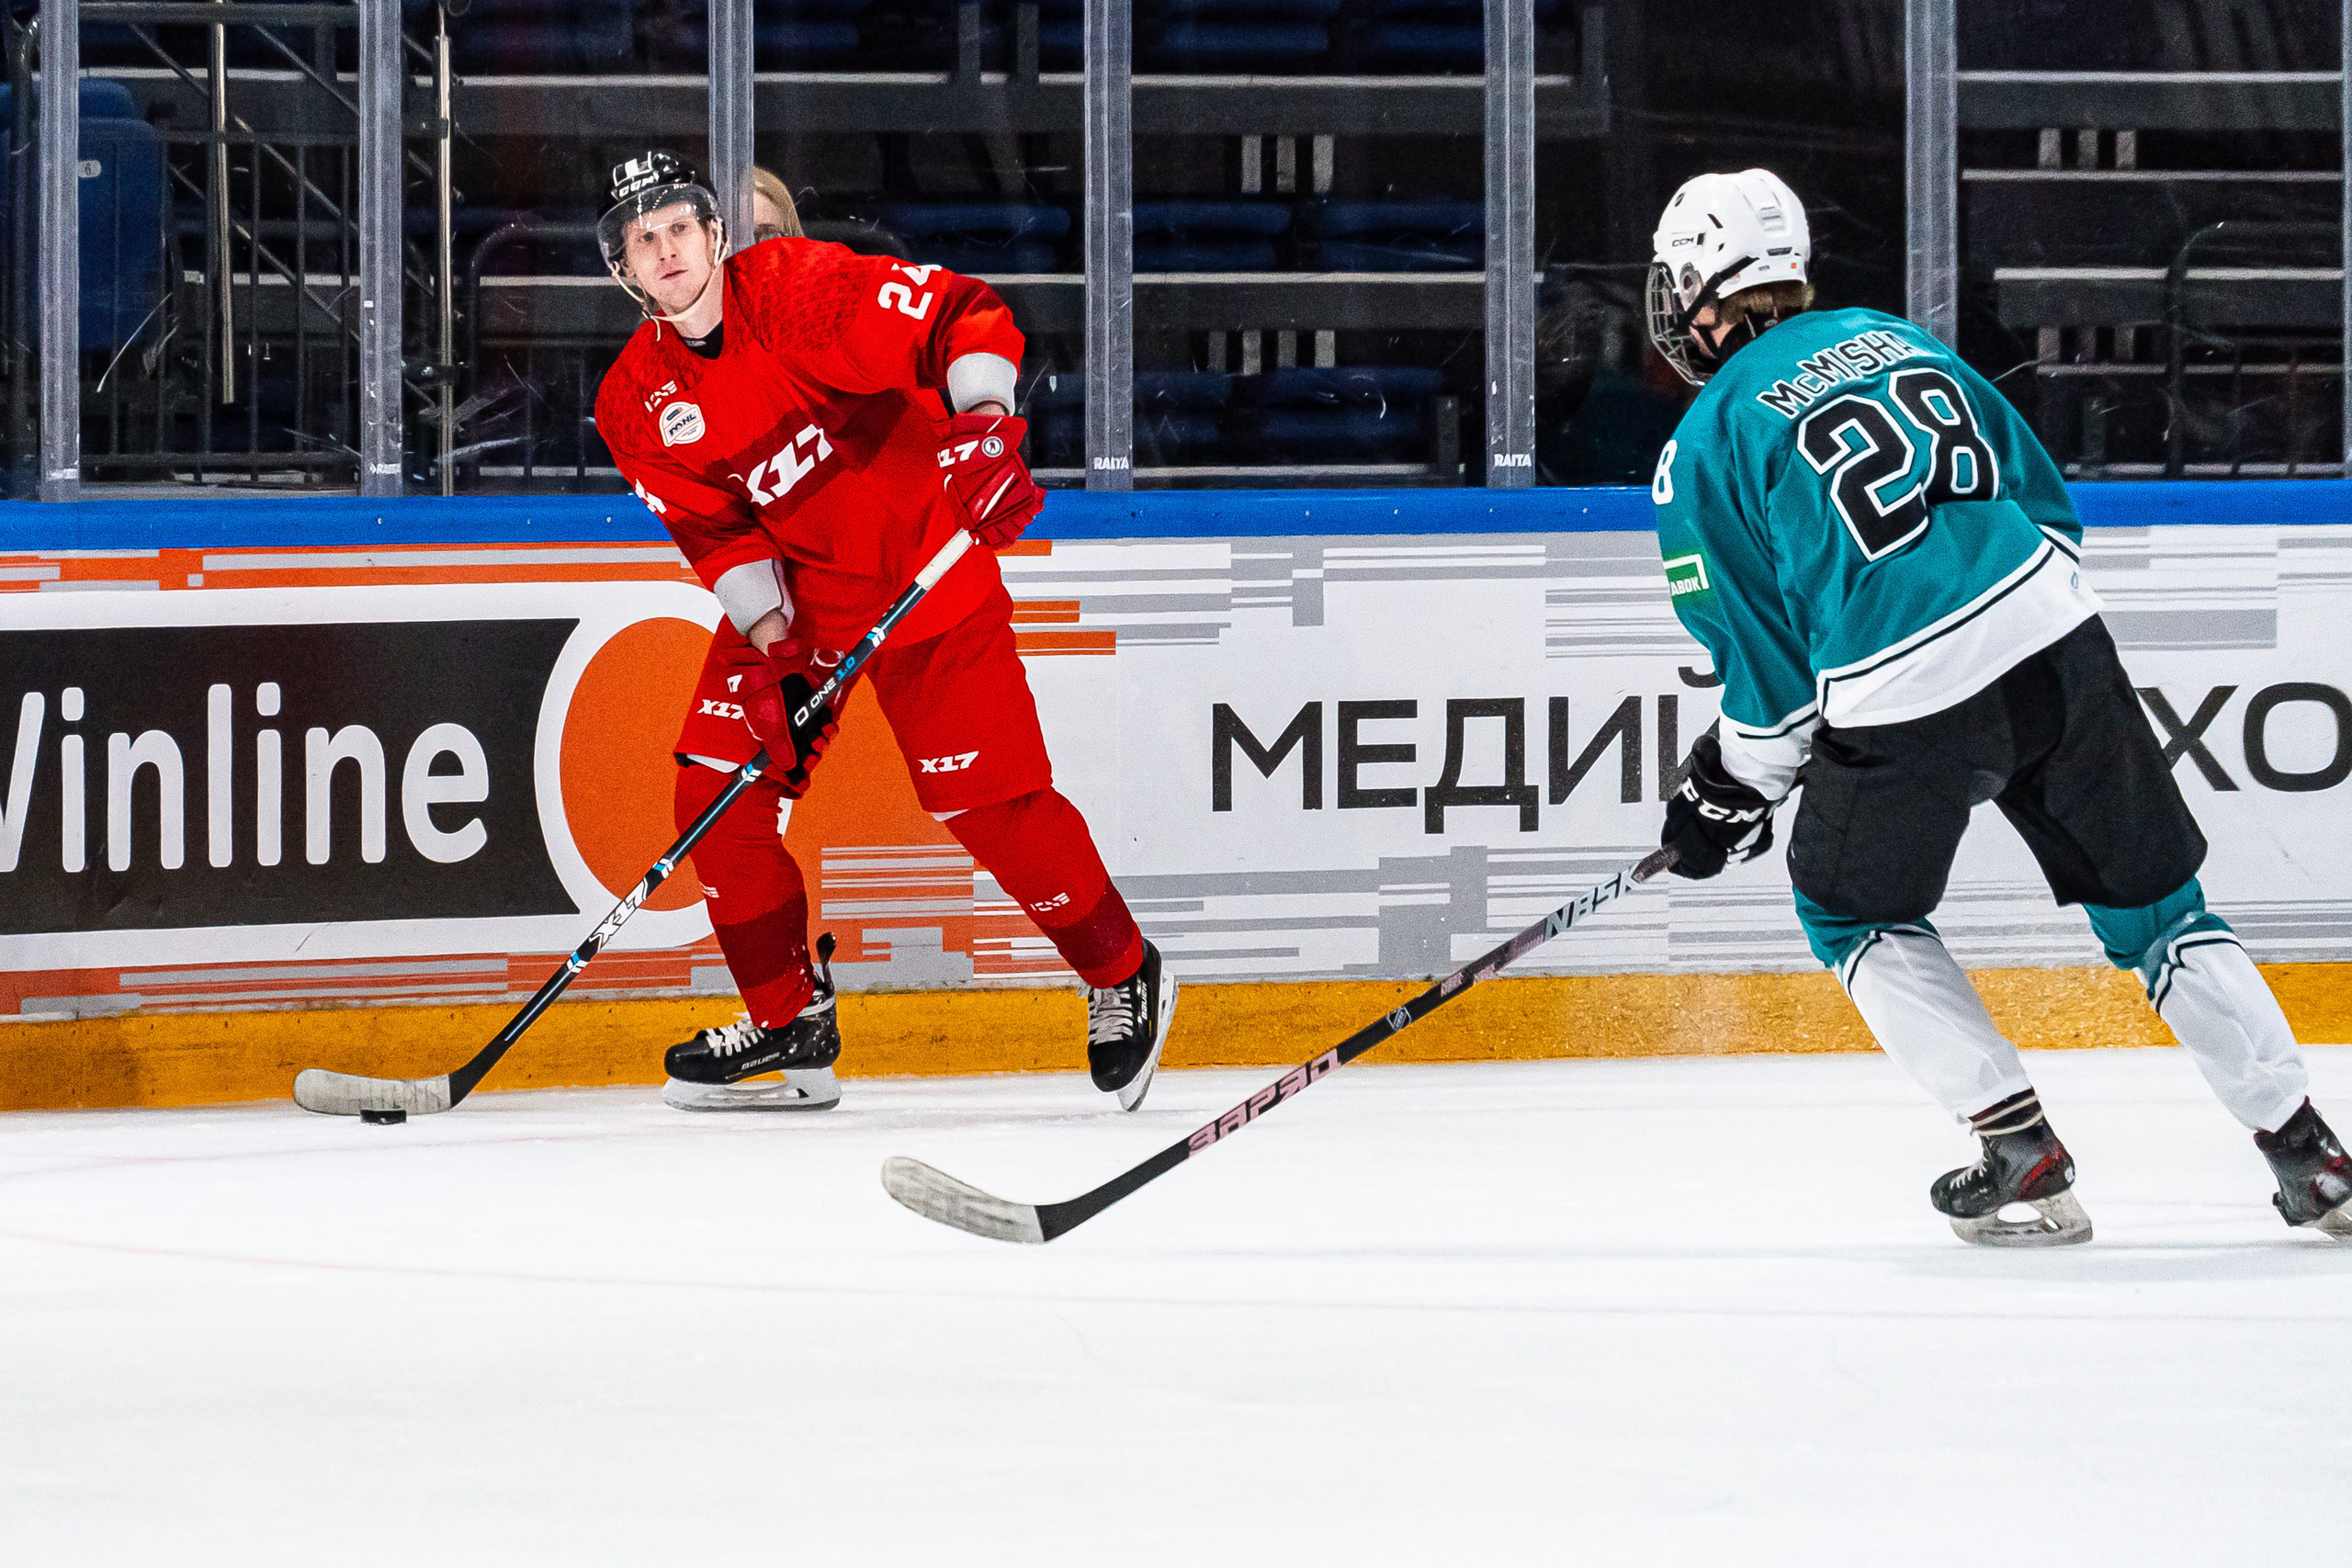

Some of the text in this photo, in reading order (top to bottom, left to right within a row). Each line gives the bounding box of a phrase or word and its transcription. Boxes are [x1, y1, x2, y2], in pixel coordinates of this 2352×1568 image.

[1672, 237, 1694, 247] CCM
[877, 263, 943, 321] 24
[937, 440, 979, 468] 17
[1093, 457, 1129, 469] RAITA
[1494, 454, 1532, 467] RAITA
[1797, 367, 1999, 562] 28
[809, 677, 837, 709] ONE
[836, 656, 855, 681] 1.0
[697, 699, 745, 720] X17
[918, 750, 979, 773] X17
[1681, 776, 1780, 824] CCM
[590, 878, 647, 950] X17
[1140, 981, 1148, 1021] BAUER
